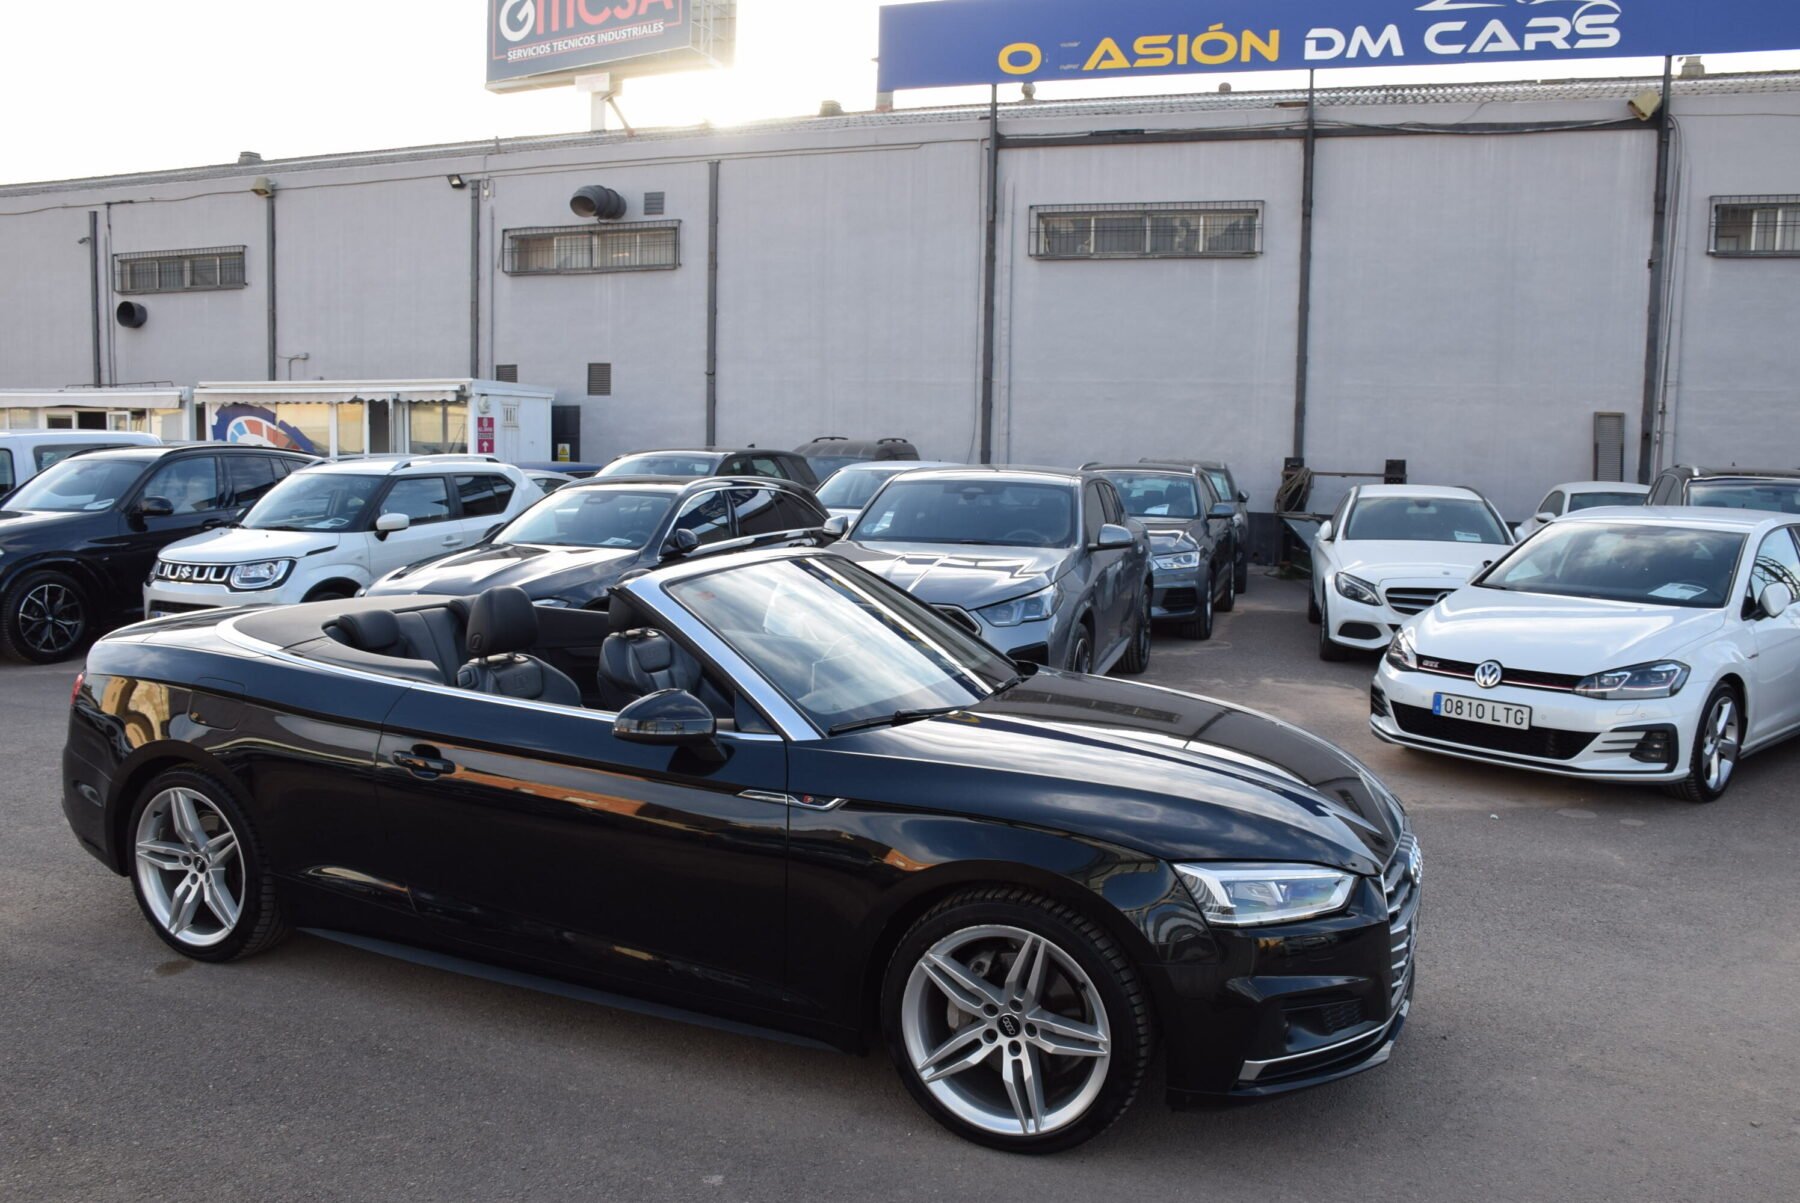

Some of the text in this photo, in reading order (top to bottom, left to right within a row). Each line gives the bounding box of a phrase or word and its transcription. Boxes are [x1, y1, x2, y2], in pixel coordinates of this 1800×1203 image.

[507, 22, 665, 61] SERVICIOS TECNICOS INDUSTRIALES
[998, 13, 1621, 75] OASIÓN DM CARS
[1444, 698, 1485, 719] 0810
[1491, 705, 1524, 726] LTG
